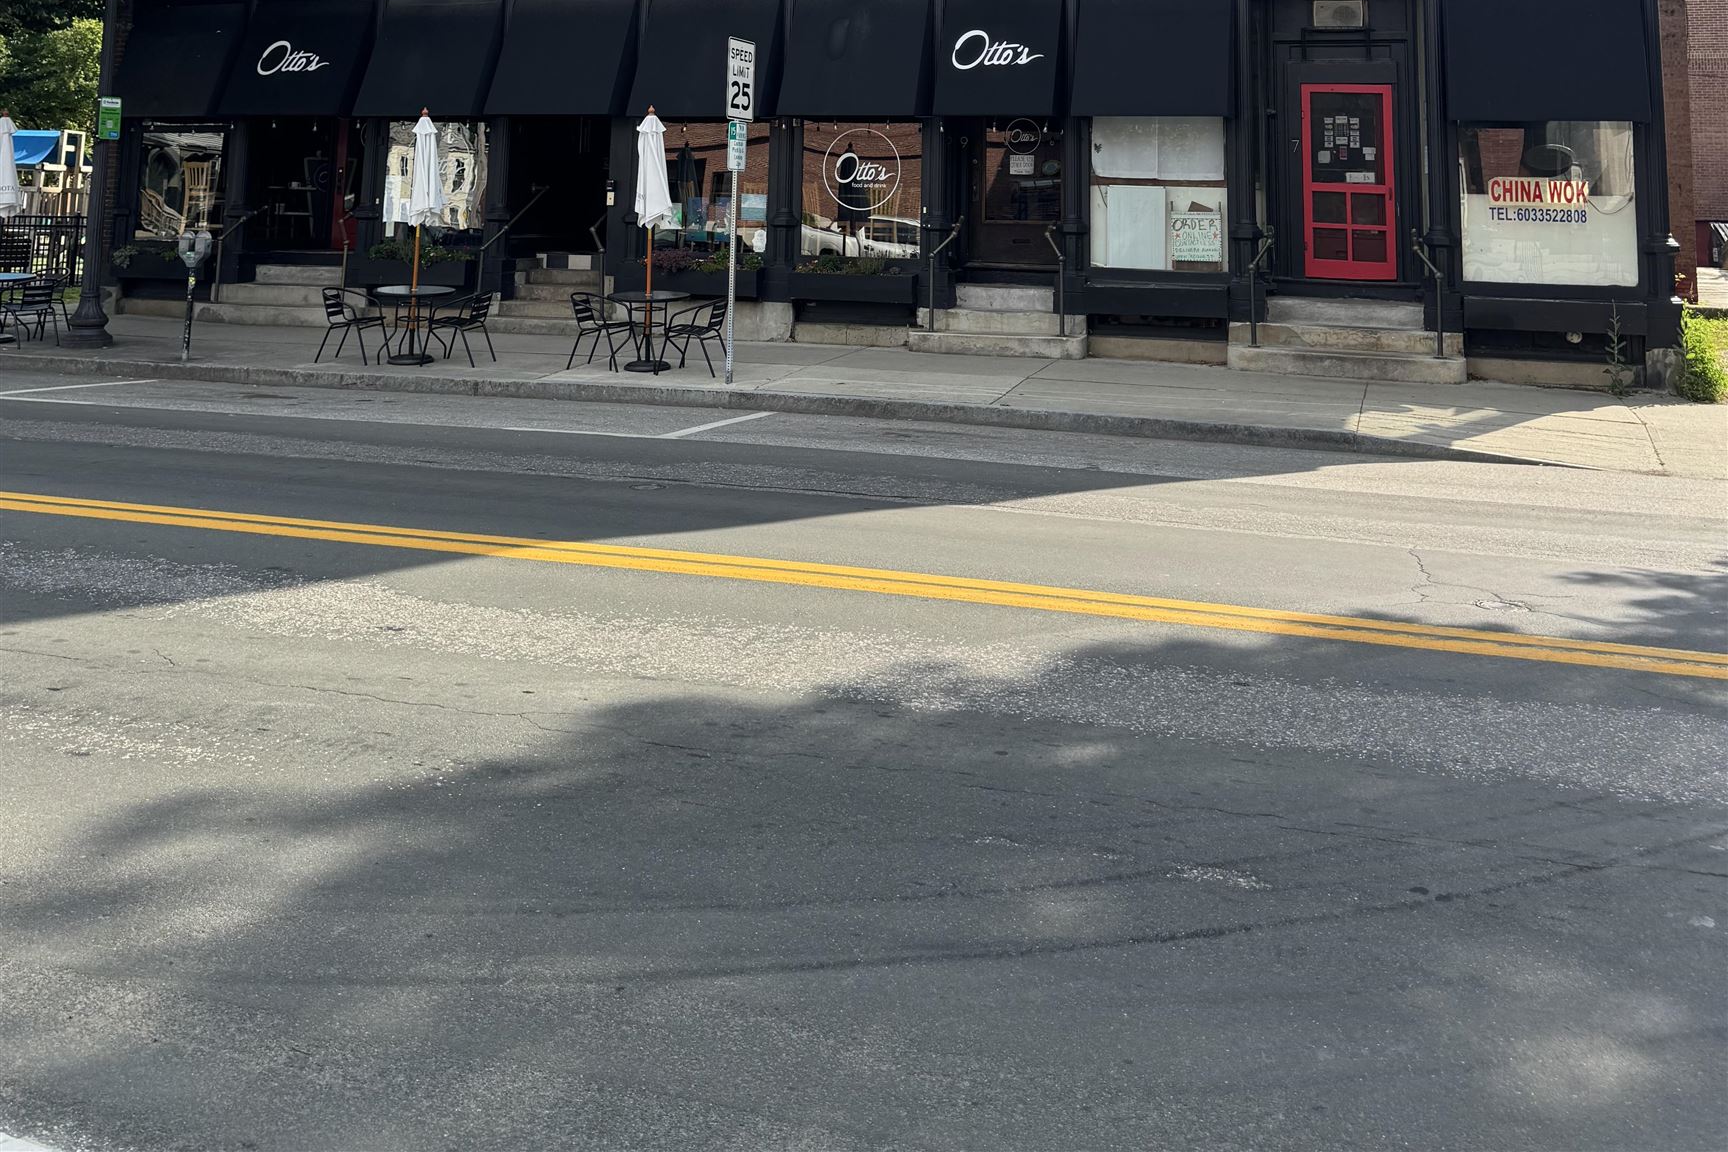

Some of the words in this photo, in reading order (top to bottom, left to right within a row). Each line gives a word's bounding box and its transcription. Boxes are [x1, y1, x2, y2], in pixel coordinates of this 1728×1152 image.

[256, 40, 330, 76] Otto's
[730, 47, 753, 64] SPEED
[951, 29, 1045, 70] Otto's
[732, 64, 750, 79] LIMIT
[730, 80, 751, 112] 25
[1291, 138, 1300, 153] 7
[835, 152, 896, 183] Otto's
[1490, 179, 1544, 203] CHINA
[1548, 180, 1588, 204] WOK
[1172, 218, 1219, 232] ORDER
[1489, 207, 1588, 224] TEL:6033522808
